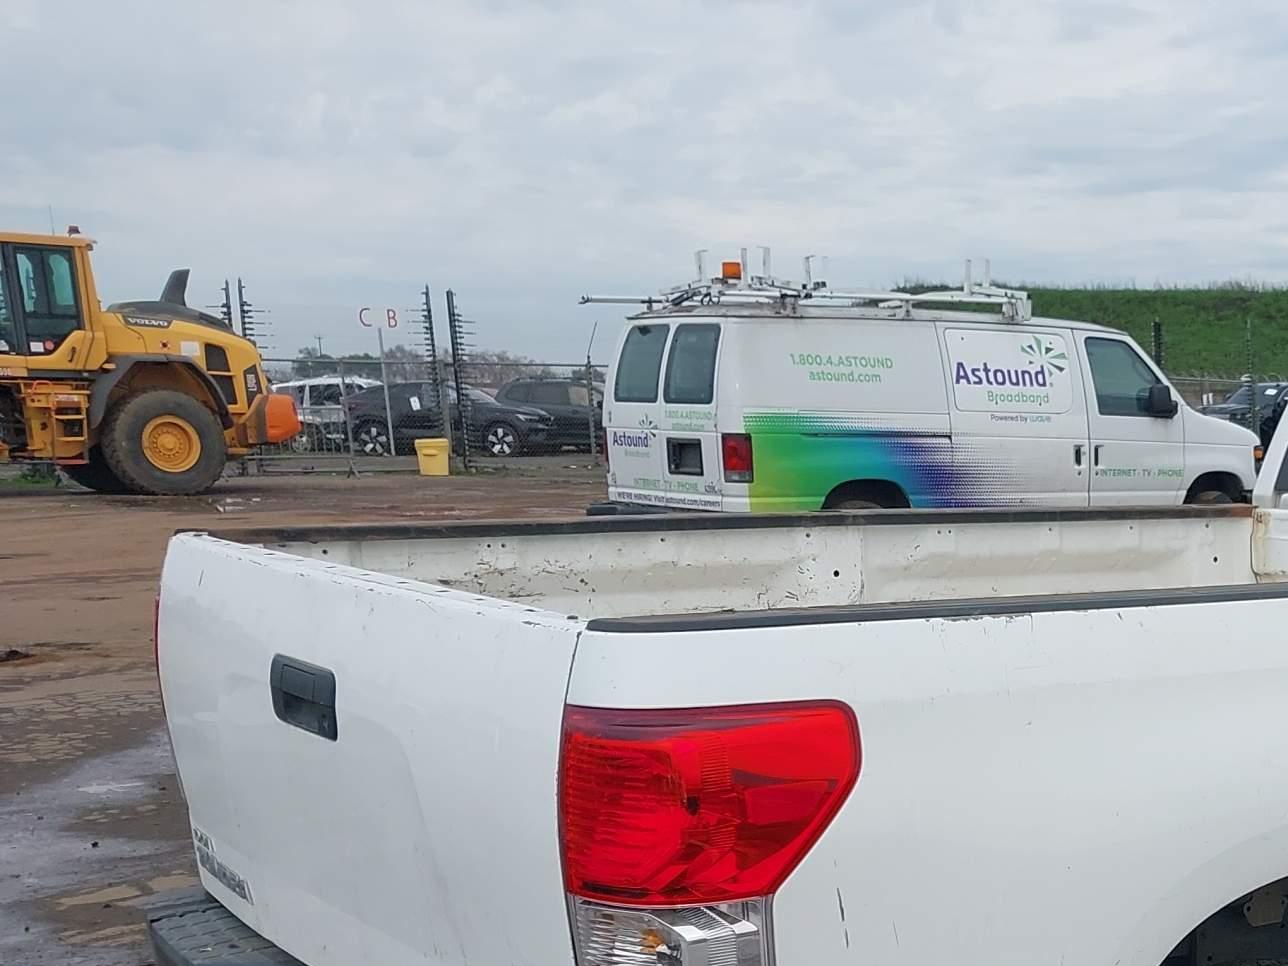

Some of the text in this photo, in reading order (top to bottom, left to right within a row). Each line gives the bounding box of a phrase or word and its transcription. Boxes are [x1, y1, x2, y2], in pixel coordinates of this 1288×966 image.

[127, 317, 168, 327] VOLVO
[386, 308, 398, 329] B
[790, 353, 894, 369] 1.800.4.ASTOUND
[808, 370, 882, 383] astound.com
[955, 361, 1047, 388] Astound
[987, 391, 1049, 406] Broadband
[990, 414, 1019, 423] Powered
[1019, 414, 1028, 424] by
[612, 431, 649, 448] Astound
[1100, 468, 1184, 478] INTERNET TV PHONE
